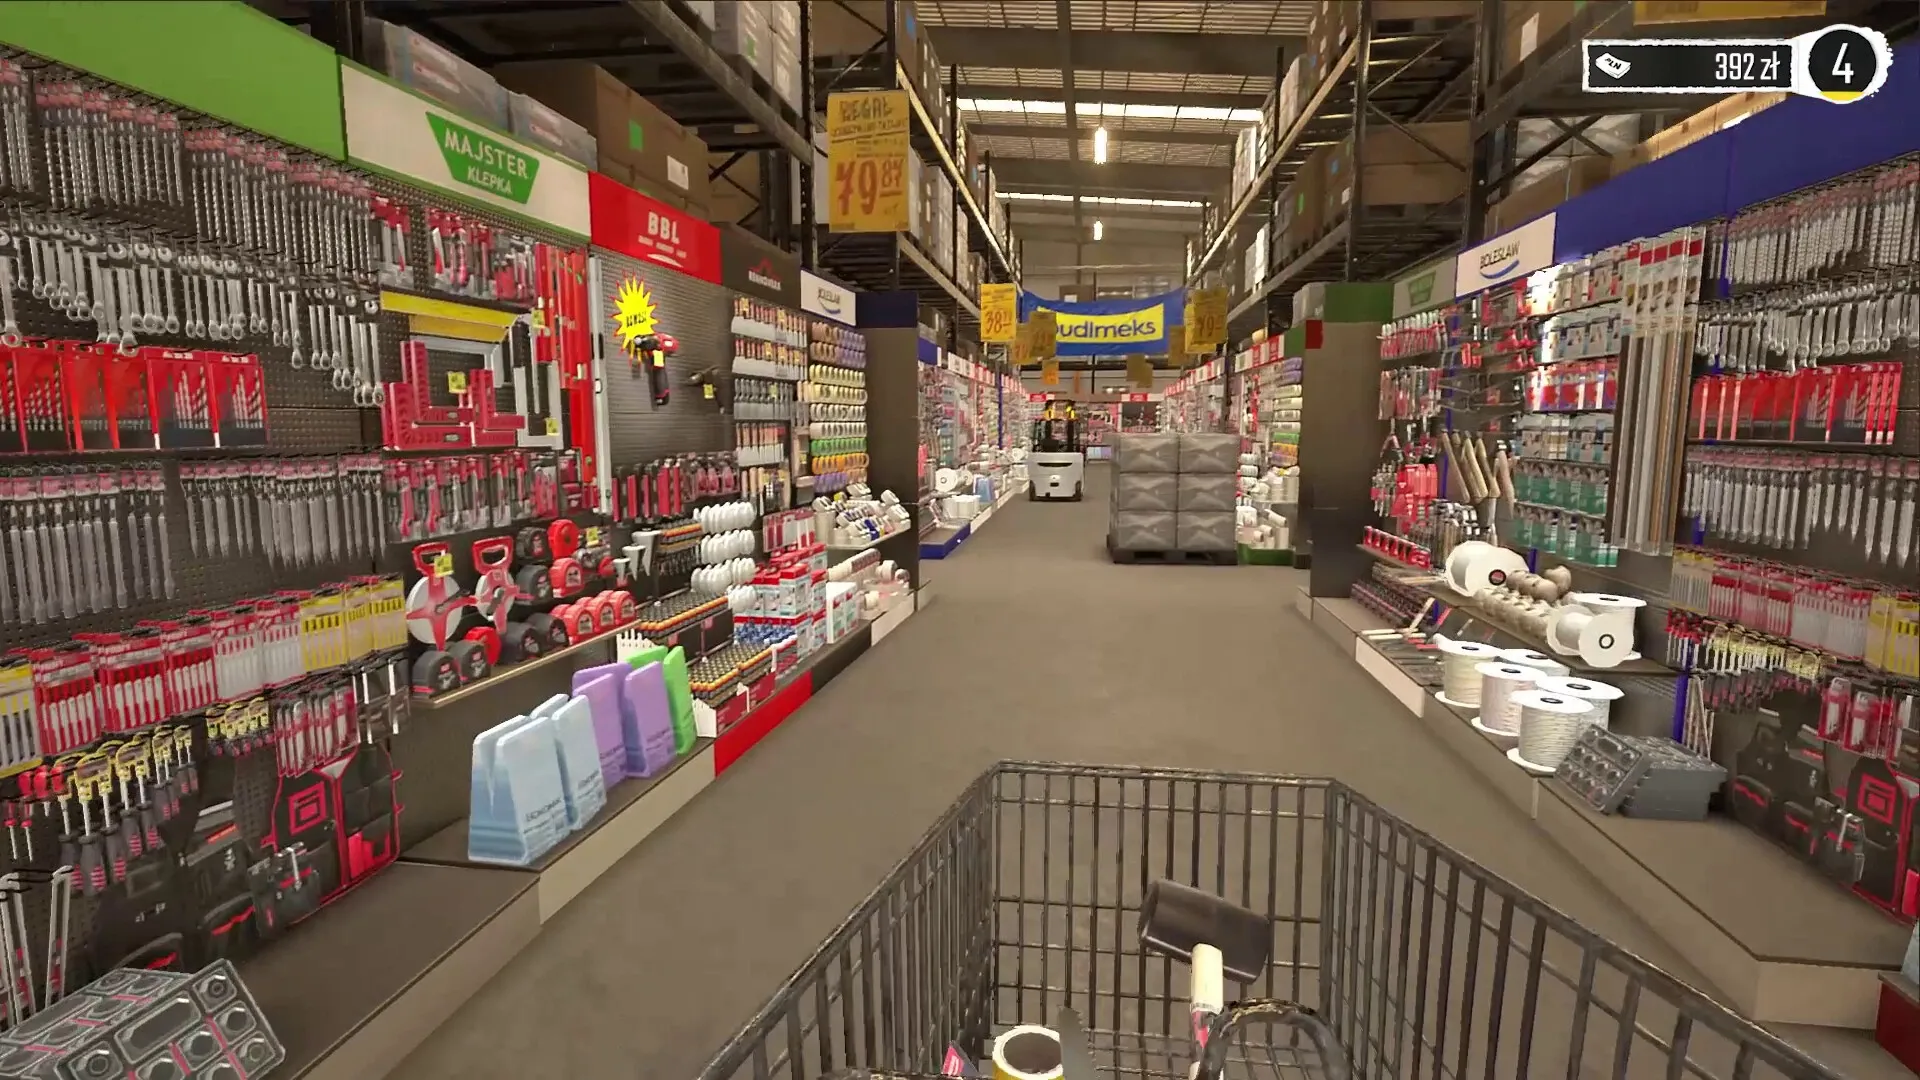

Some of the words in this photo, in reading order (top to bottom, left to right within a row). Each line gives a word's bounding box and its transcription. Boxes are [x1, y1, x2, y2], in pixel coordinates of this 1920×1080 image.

[444, 127, 528, 179] MAJSTER
[467, 165, 514, 195] KLEPKA
[647, 211, 680, 244] BBL
